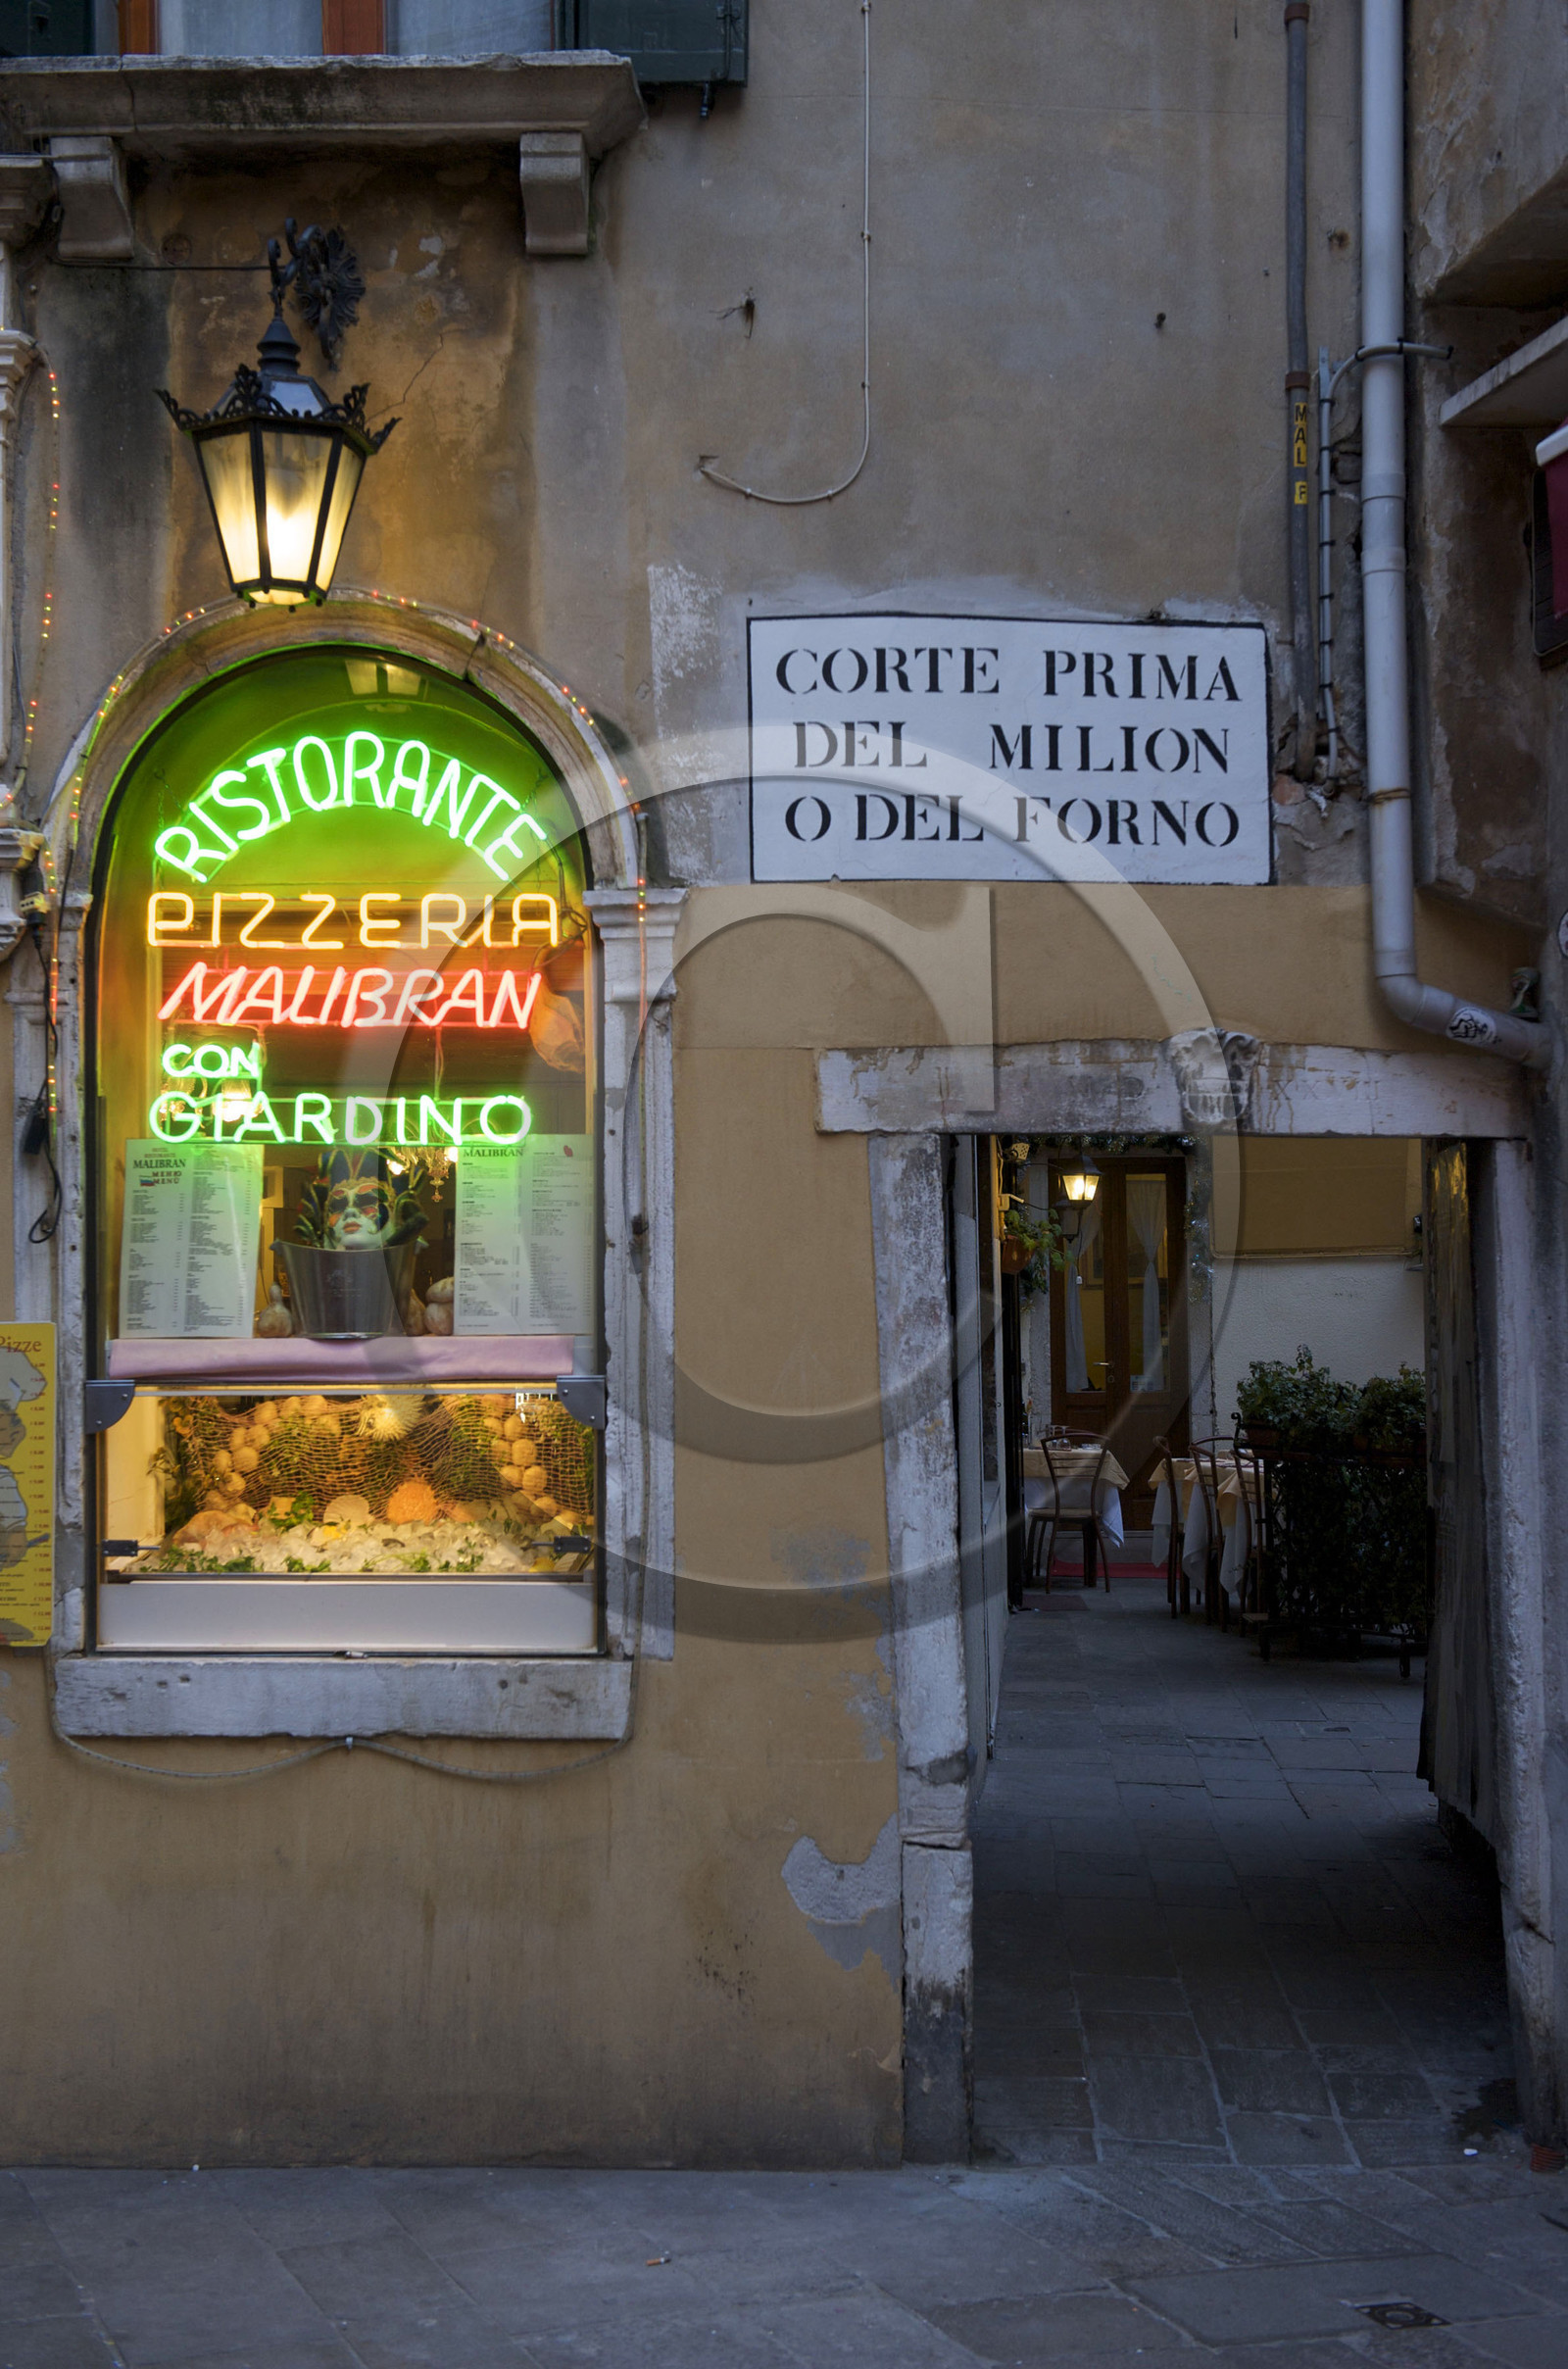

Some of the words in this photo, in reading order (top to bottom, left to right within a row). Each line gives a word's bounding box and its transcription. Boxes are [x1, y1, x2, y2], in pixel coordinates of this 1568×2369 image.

[775, 646, 1000, 695] CORTE
[1043, 650, 1243, 702] PRIMA
[793, 720, 928, 769] DEL
[988, 723, 1230, 775] MILION
[154, 730, 548, 883] RISTORANTE
[785, 795, 832, 842] O
[854, 793, 984, 843] DEL
[1012, 796, 1241, 848] FORNO
[147, 891, 559, 949] PIZZERIA
[157, 961, 543, 1029] MALIBRAN
[162, 1040, 262, 1078] CON
[148, 1090, 533, 1146] GIARDINO
[132, 1159, 186, 1169] MALIBRAN
[464, 1148, 524, 1158] MALIBRAN
